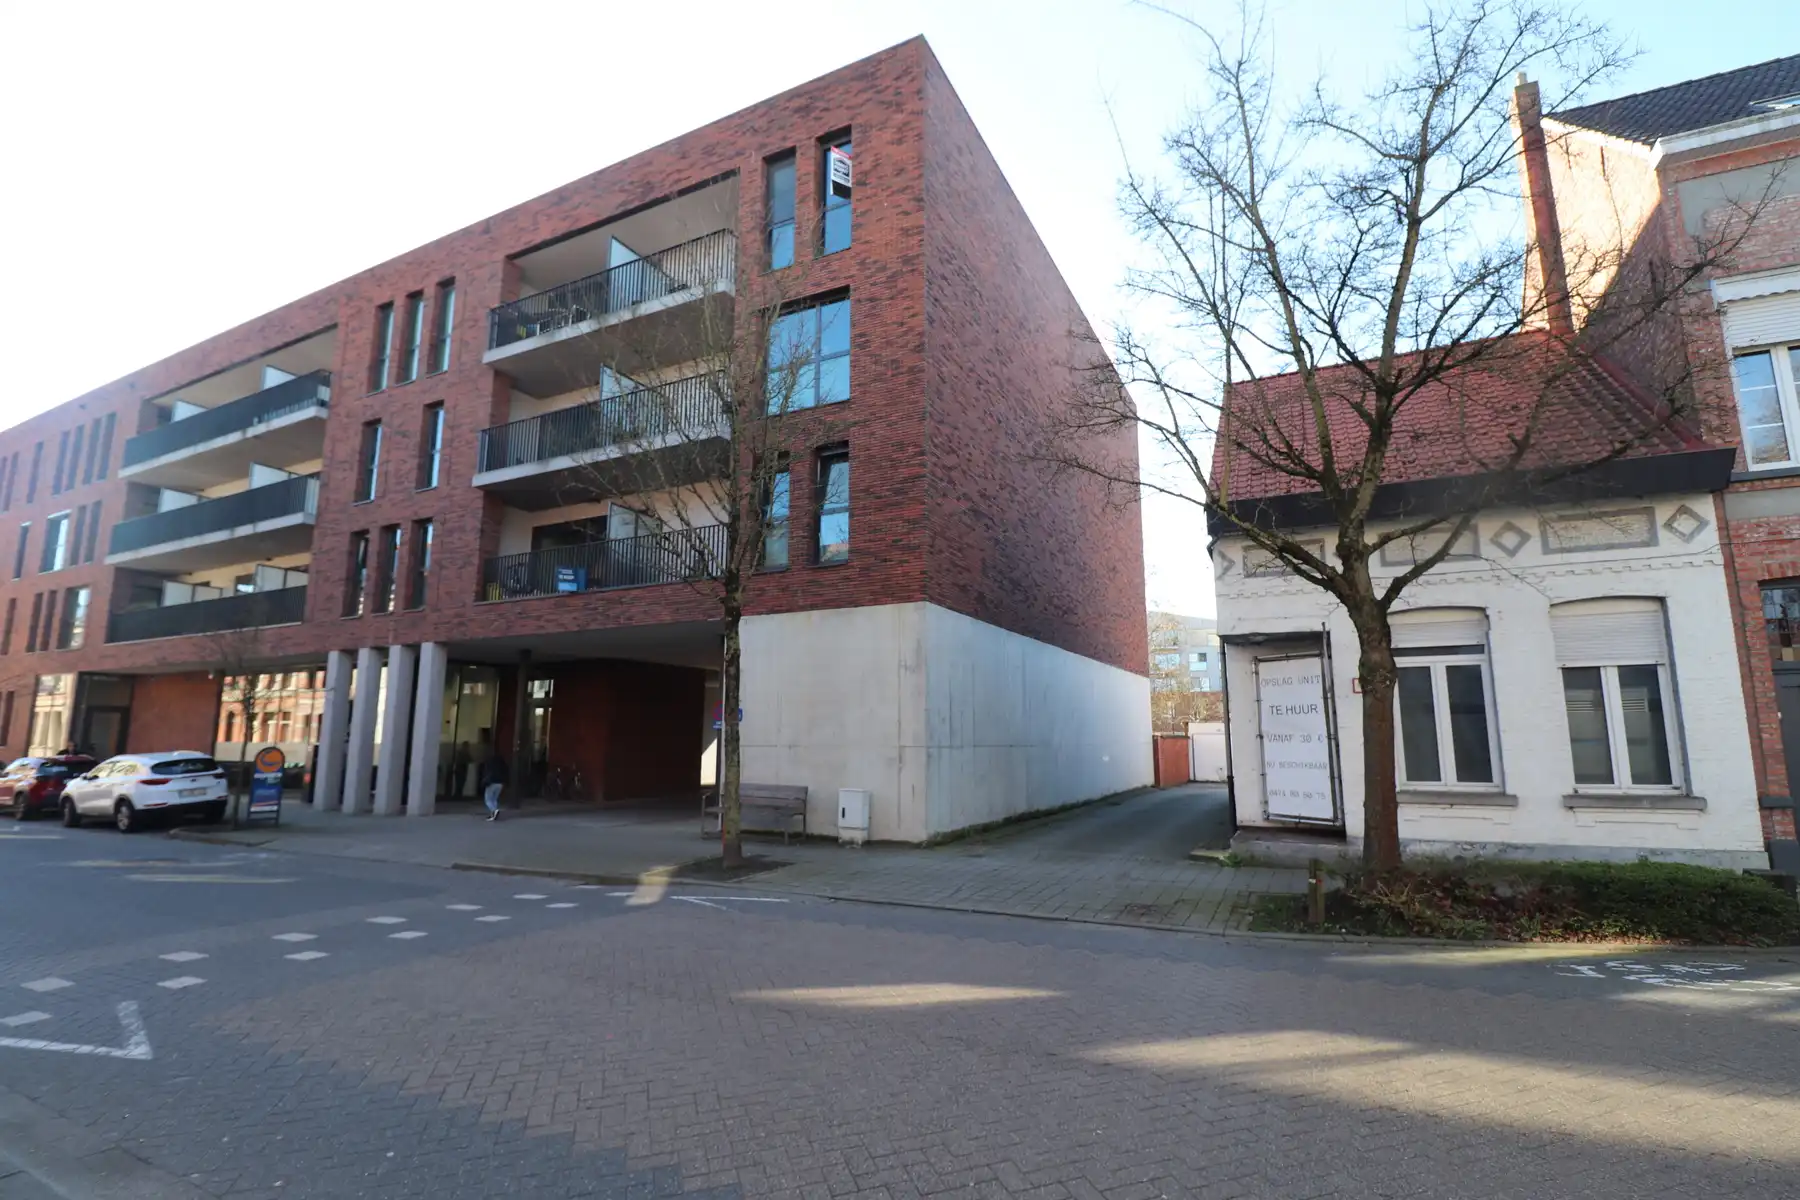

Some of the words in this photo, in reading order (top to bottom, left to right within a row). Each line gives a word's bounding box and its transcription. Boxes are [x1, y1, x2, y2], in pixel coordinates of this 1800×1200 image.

[1260, 676, 1293, 688] OPSLAG
[1297, 674, 1321, 685] UNIT
[1268, 704, 1283, 716] TE
[1285, 703, 1319, 715] HUUR
[1267, 733, 1295, 744] VANAF
[1299, 733, 1312, 744] 30
